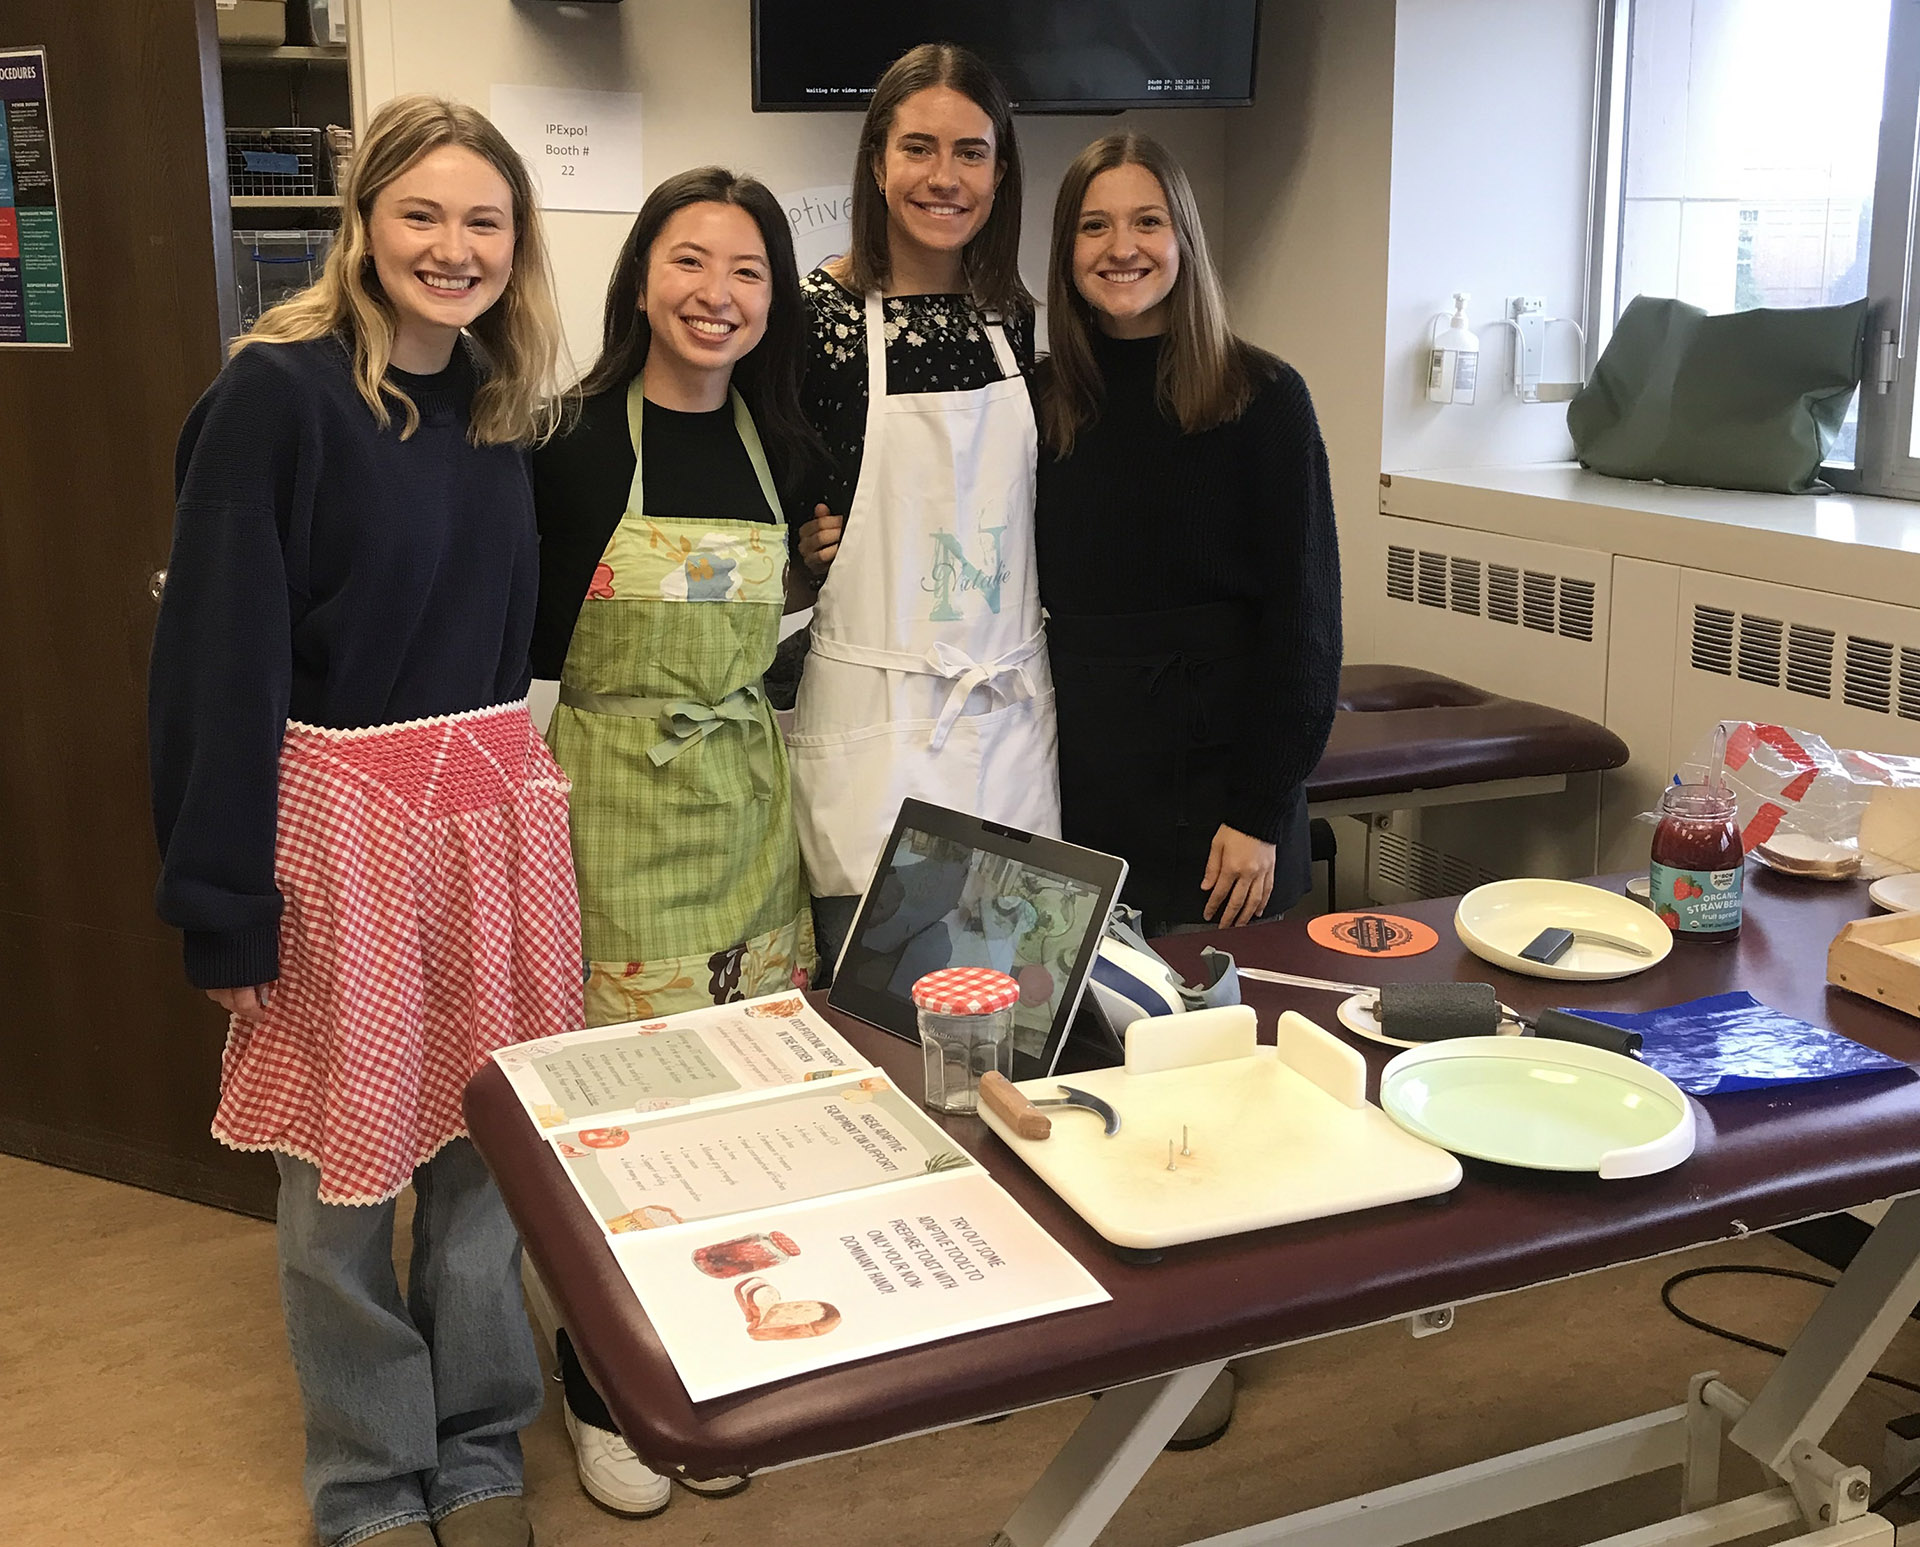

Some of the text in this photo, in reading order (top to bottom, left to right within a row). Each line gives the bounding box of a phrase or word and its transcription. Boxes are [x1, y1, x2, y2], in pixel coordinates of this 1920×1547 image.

[545, 124, 588, 138] IPExpo!
[545, 144, 590, 156] Booth #
[561, 165, 575, 176] 22
[1686, 900, 1741, 915] STRAWBER
[1703, 892, 1738, 903] ORGANIC
[779, 1035, 799, 1045] THE
[786, 1017, 847, 1067] OCCUPATIONAL THERAPY
[787, 1043, 816, 1063] KITCHEN
[822, 1104, 862, 1135] EQUIPMENT
[851, 1134, 871, 1144] CAN
[857, 1113, 908, 1153] AREAS ADAPTIVE
[621, 1160, 635, 1169] And
[679, 1149, 694, 1158] Low
[700, 1146, 740, 1186] Minimal grip strength
[718, 1142, 741, 1160] Low tone
[738, 1138, 792, 1191] Hand coordination difficulties
[621, 1168, 639, 1181] many
[638, 1156, 670, 1186] Support safety
[663, 1164, 684, 1179] energy
[678, 1177, 707, 1202] conservation
[886, 1218, 960, 1290] PREPARE TOAST WITH
[914, 1214, 986, 1282] ADAPTIVE TOOLS TO
[947, 1216, 1007, 1268] TRY OUT SOME
[837, 1234, 898, 1295] DOMINANT HAND!
[863, 1229, 927, 1290] ONLY YOUR NON-
